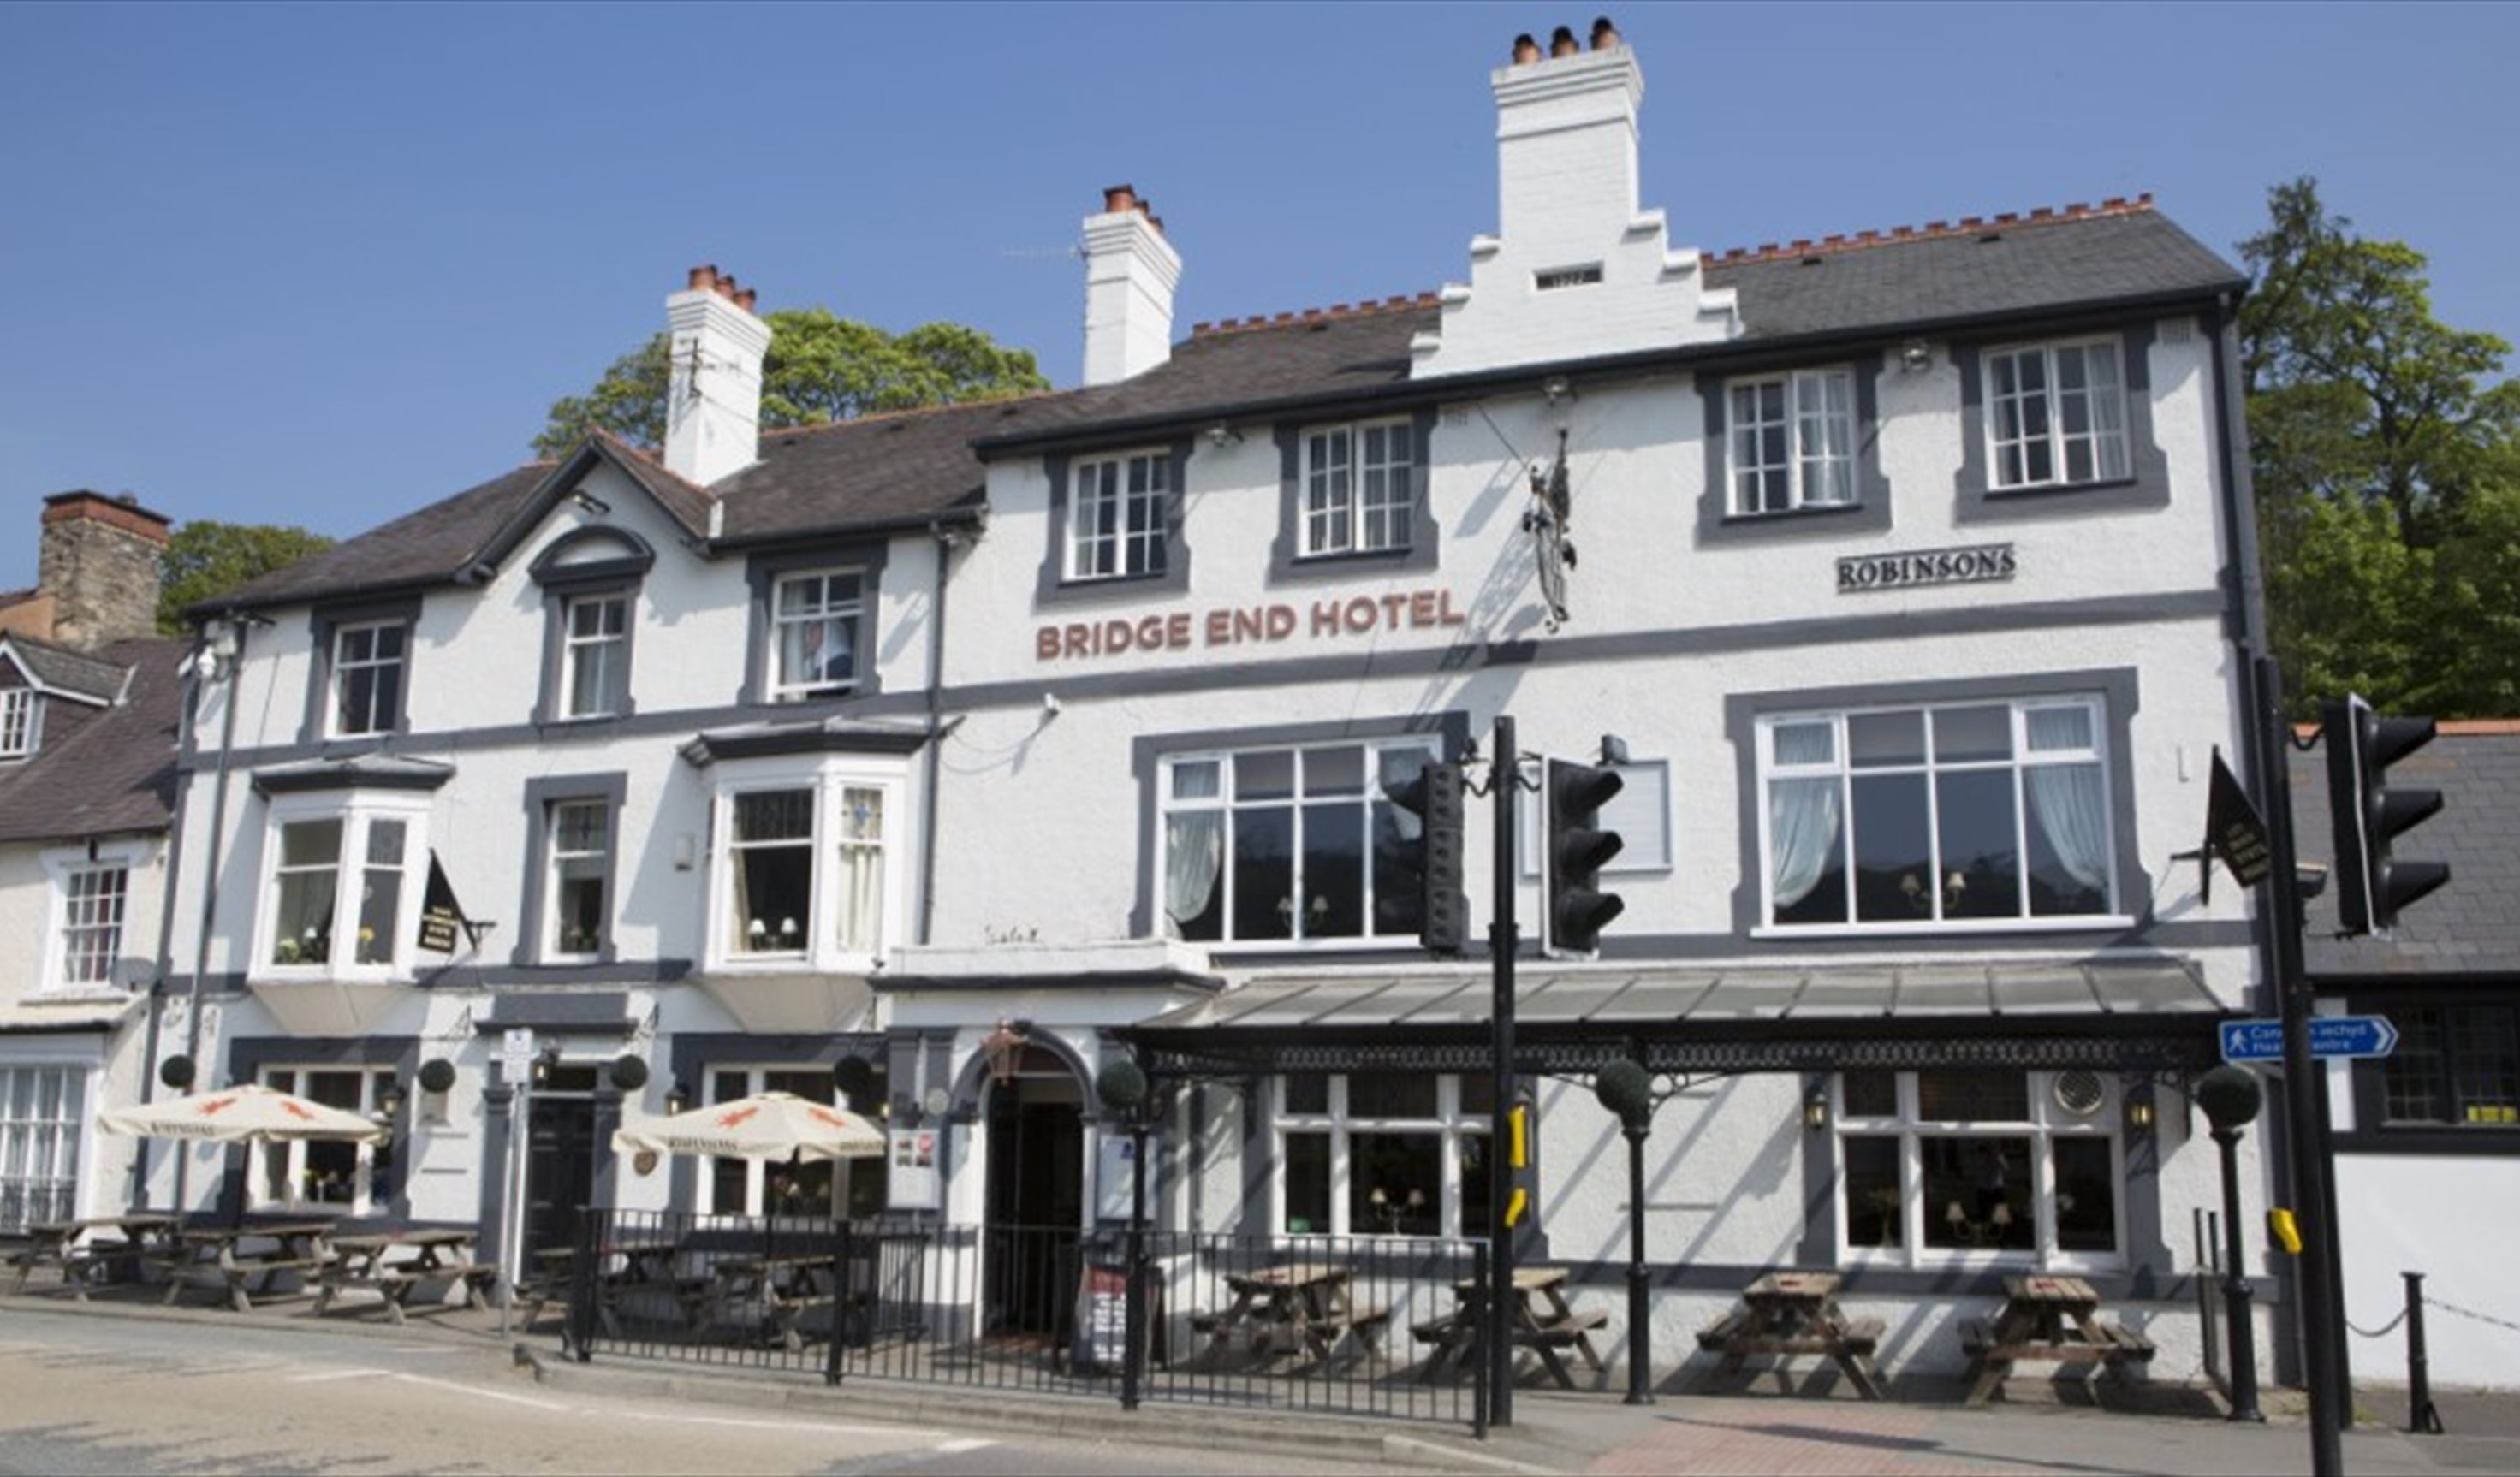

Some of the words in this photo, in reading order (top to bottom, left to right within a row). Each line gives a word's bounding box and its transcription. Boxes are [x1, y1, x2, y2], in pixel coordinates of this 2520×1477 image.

[1838, 548, 2016, 585] ROBINSONS
[1036, 613, 1191, 661] BRIDGE
[1207, 605, 1297, 647] END
[1311, 589, 1465, 638] HOTEL
